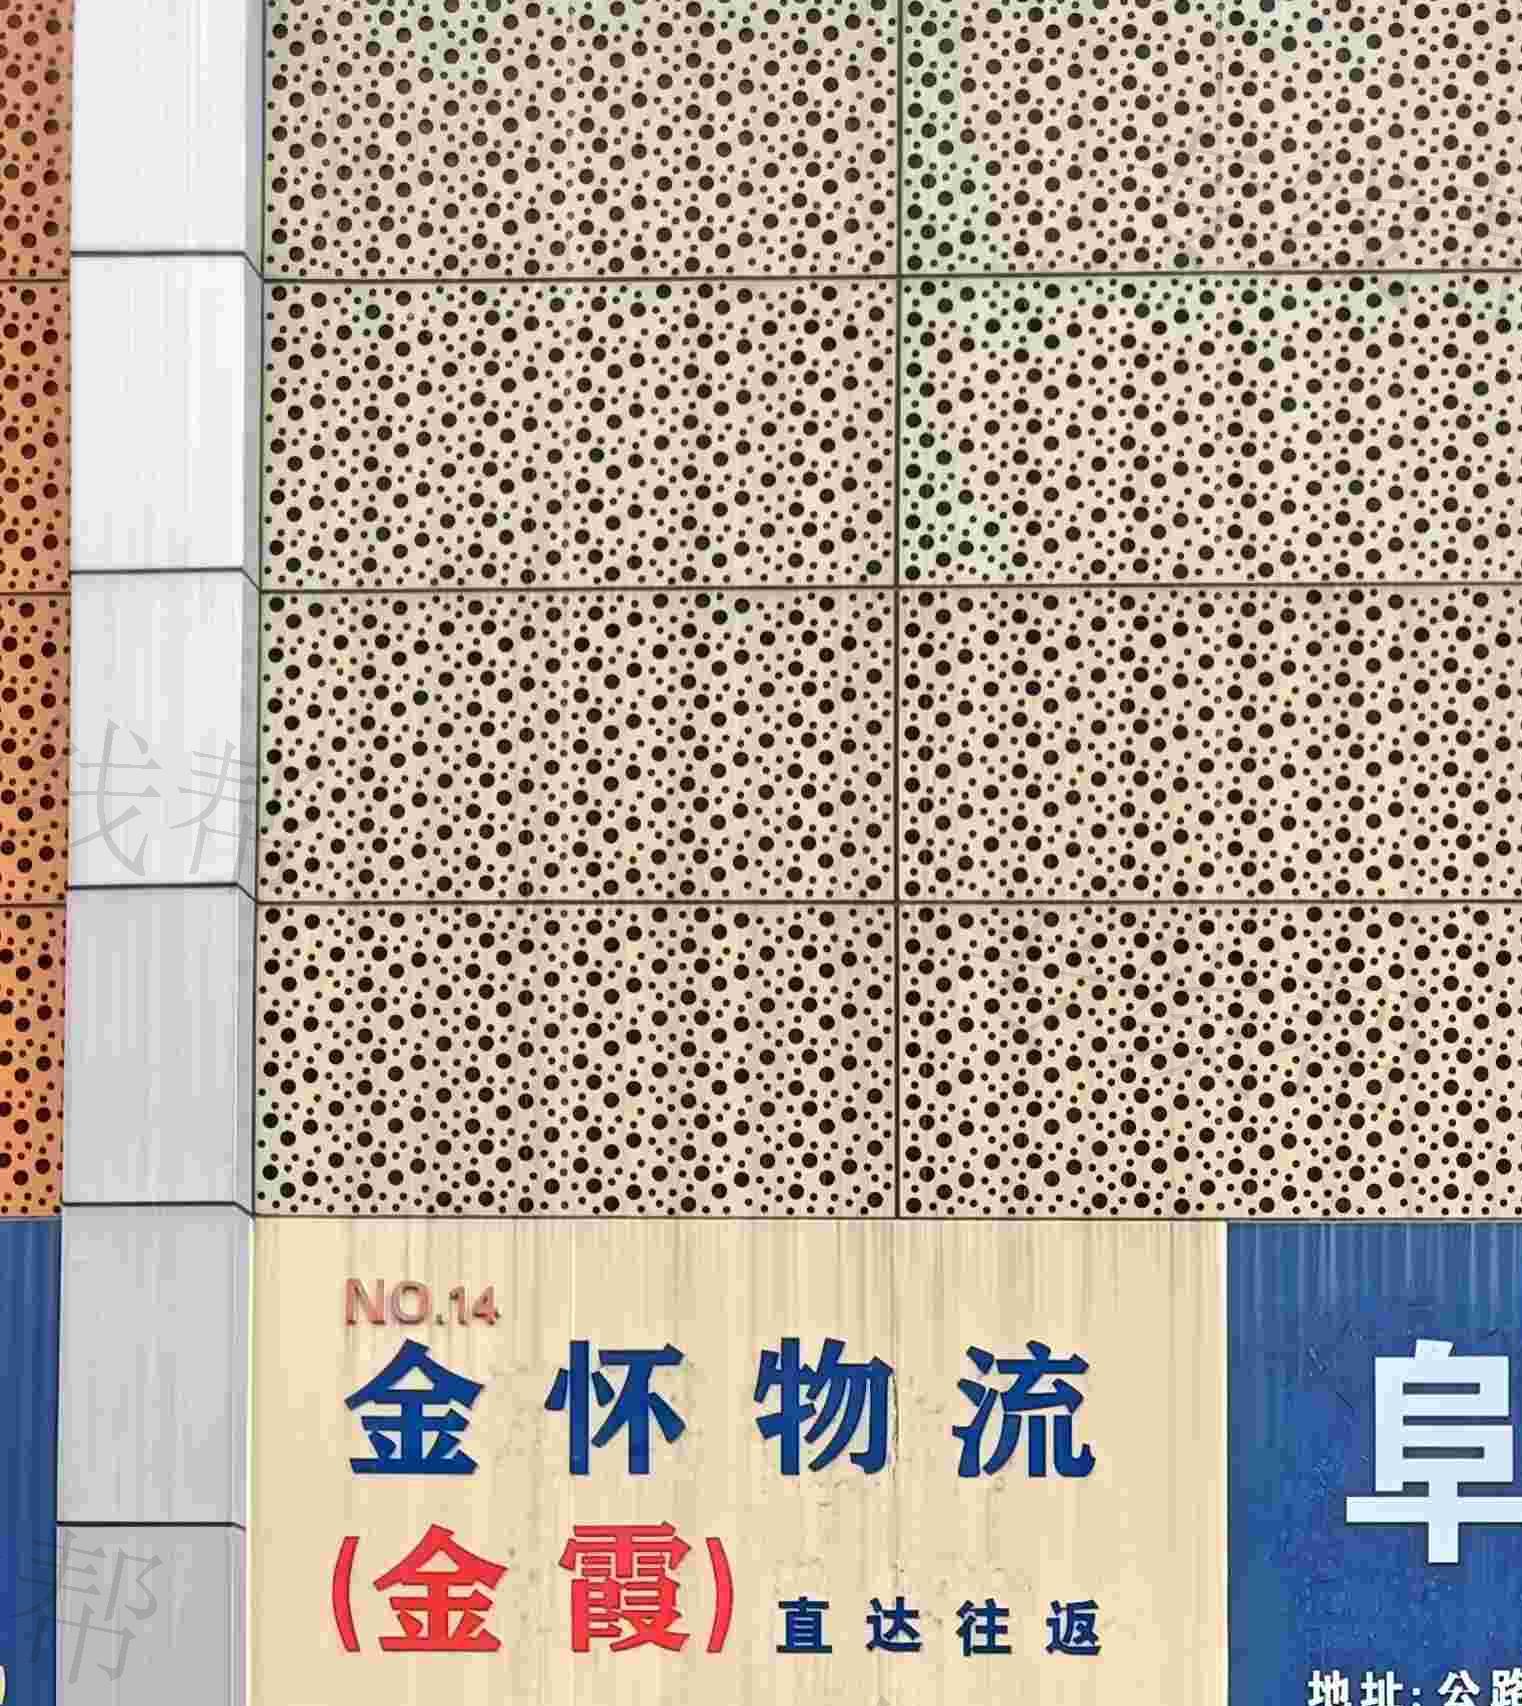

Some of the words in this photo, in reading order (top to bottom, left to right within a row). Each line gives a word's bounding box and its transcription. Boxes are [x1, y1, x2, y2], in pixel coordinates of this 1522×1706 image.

[342, 1276, 502, 1328] NO.14
[344, 1336, 1098, 1479] 金怀物流
[330, 1520, 735, 1656] (金霞)
[774, 1596, 1103, 1658] 直达往返
